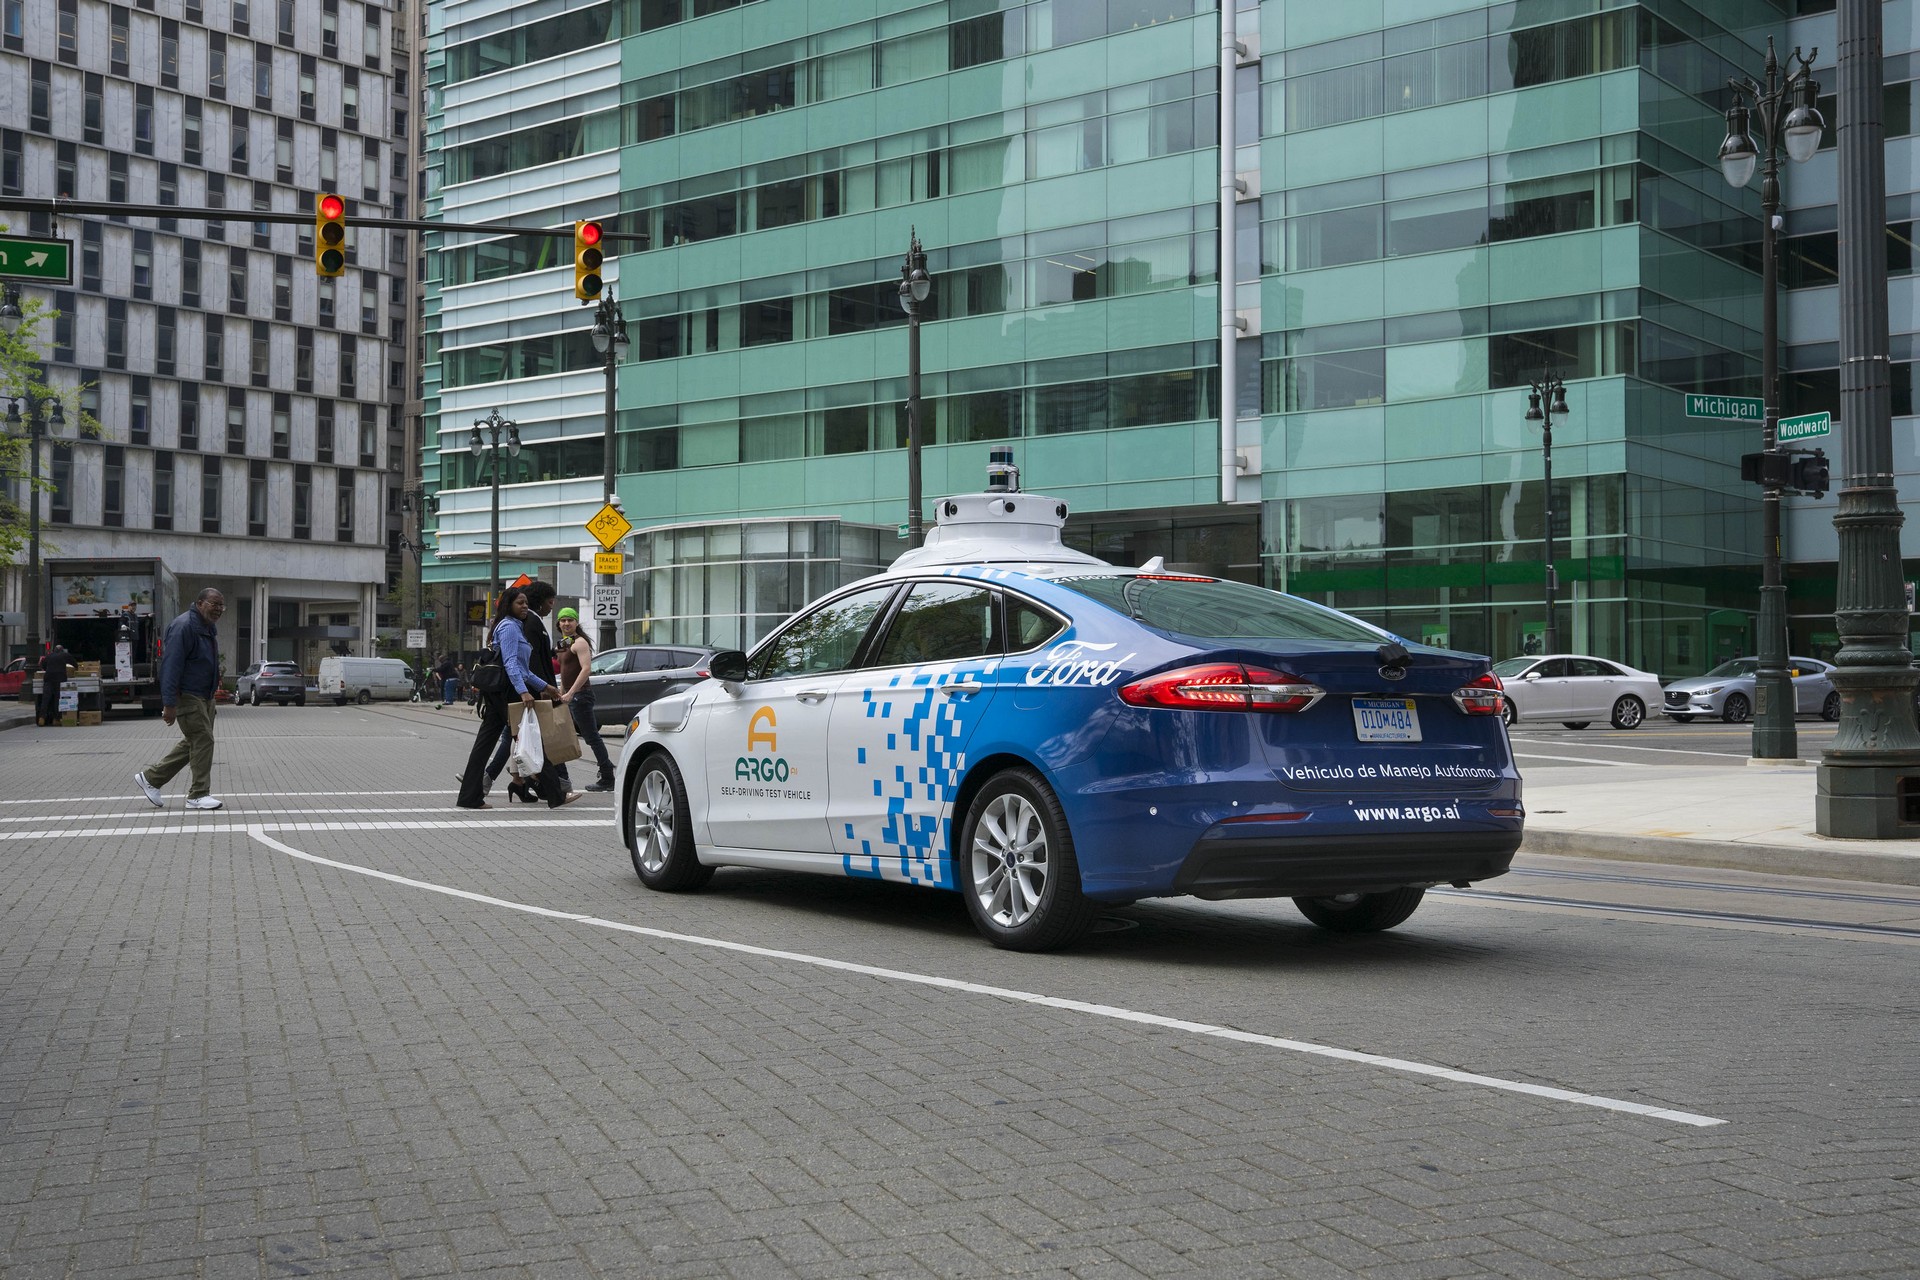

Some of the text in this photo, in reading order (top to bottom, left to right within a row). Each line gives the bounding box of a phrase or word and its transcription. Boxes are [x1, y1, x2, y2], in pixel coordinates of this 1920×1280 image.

[1694, 397, 1757, 418] Michigan
[1780, 417, 1828, 437] Woodward
[597, 603, 619, 616] 25
[1025, 640, 1138, 687] Ford
[735, 757, 789, 783] ARGO
[1357, 764, 1377, 778] de
[1379, 763, 1432, 779] Manejo
[1434, 764, 1496, 778] Autónomo
[721, 786, 811, 800] SELF-DRIVING TEST VEHICLE
[1354, 804, 1460, 822] www.argo.ai
